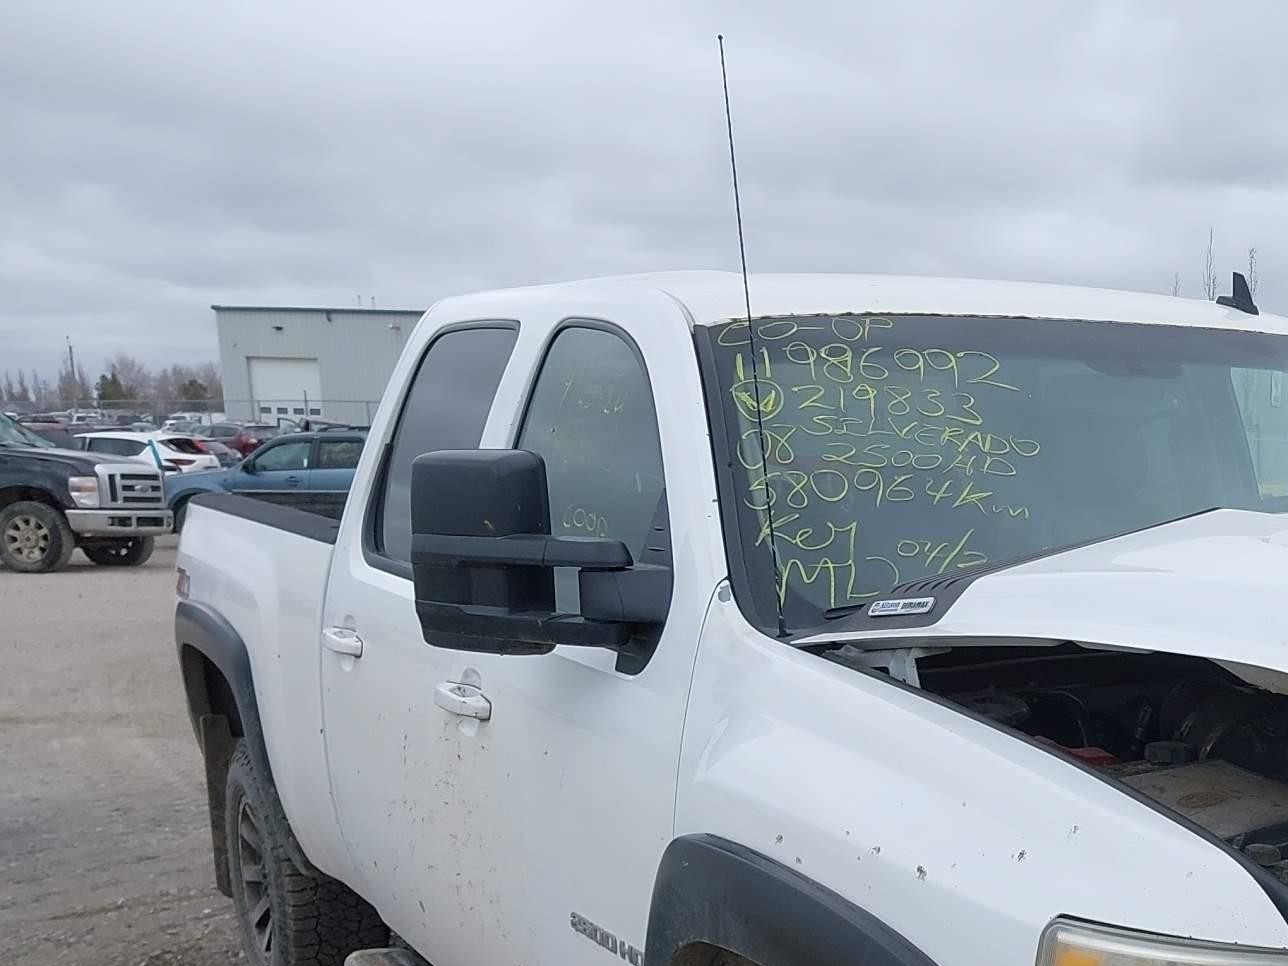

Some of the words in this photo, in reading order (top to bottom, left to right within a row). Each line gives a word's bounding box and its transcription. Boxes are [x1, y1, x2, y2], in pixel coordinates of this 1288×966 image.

[735, 341, 1021, 391] 11986992
[791, 383, 984, 425] 219833
[822, 443, 943, 468] 2500
